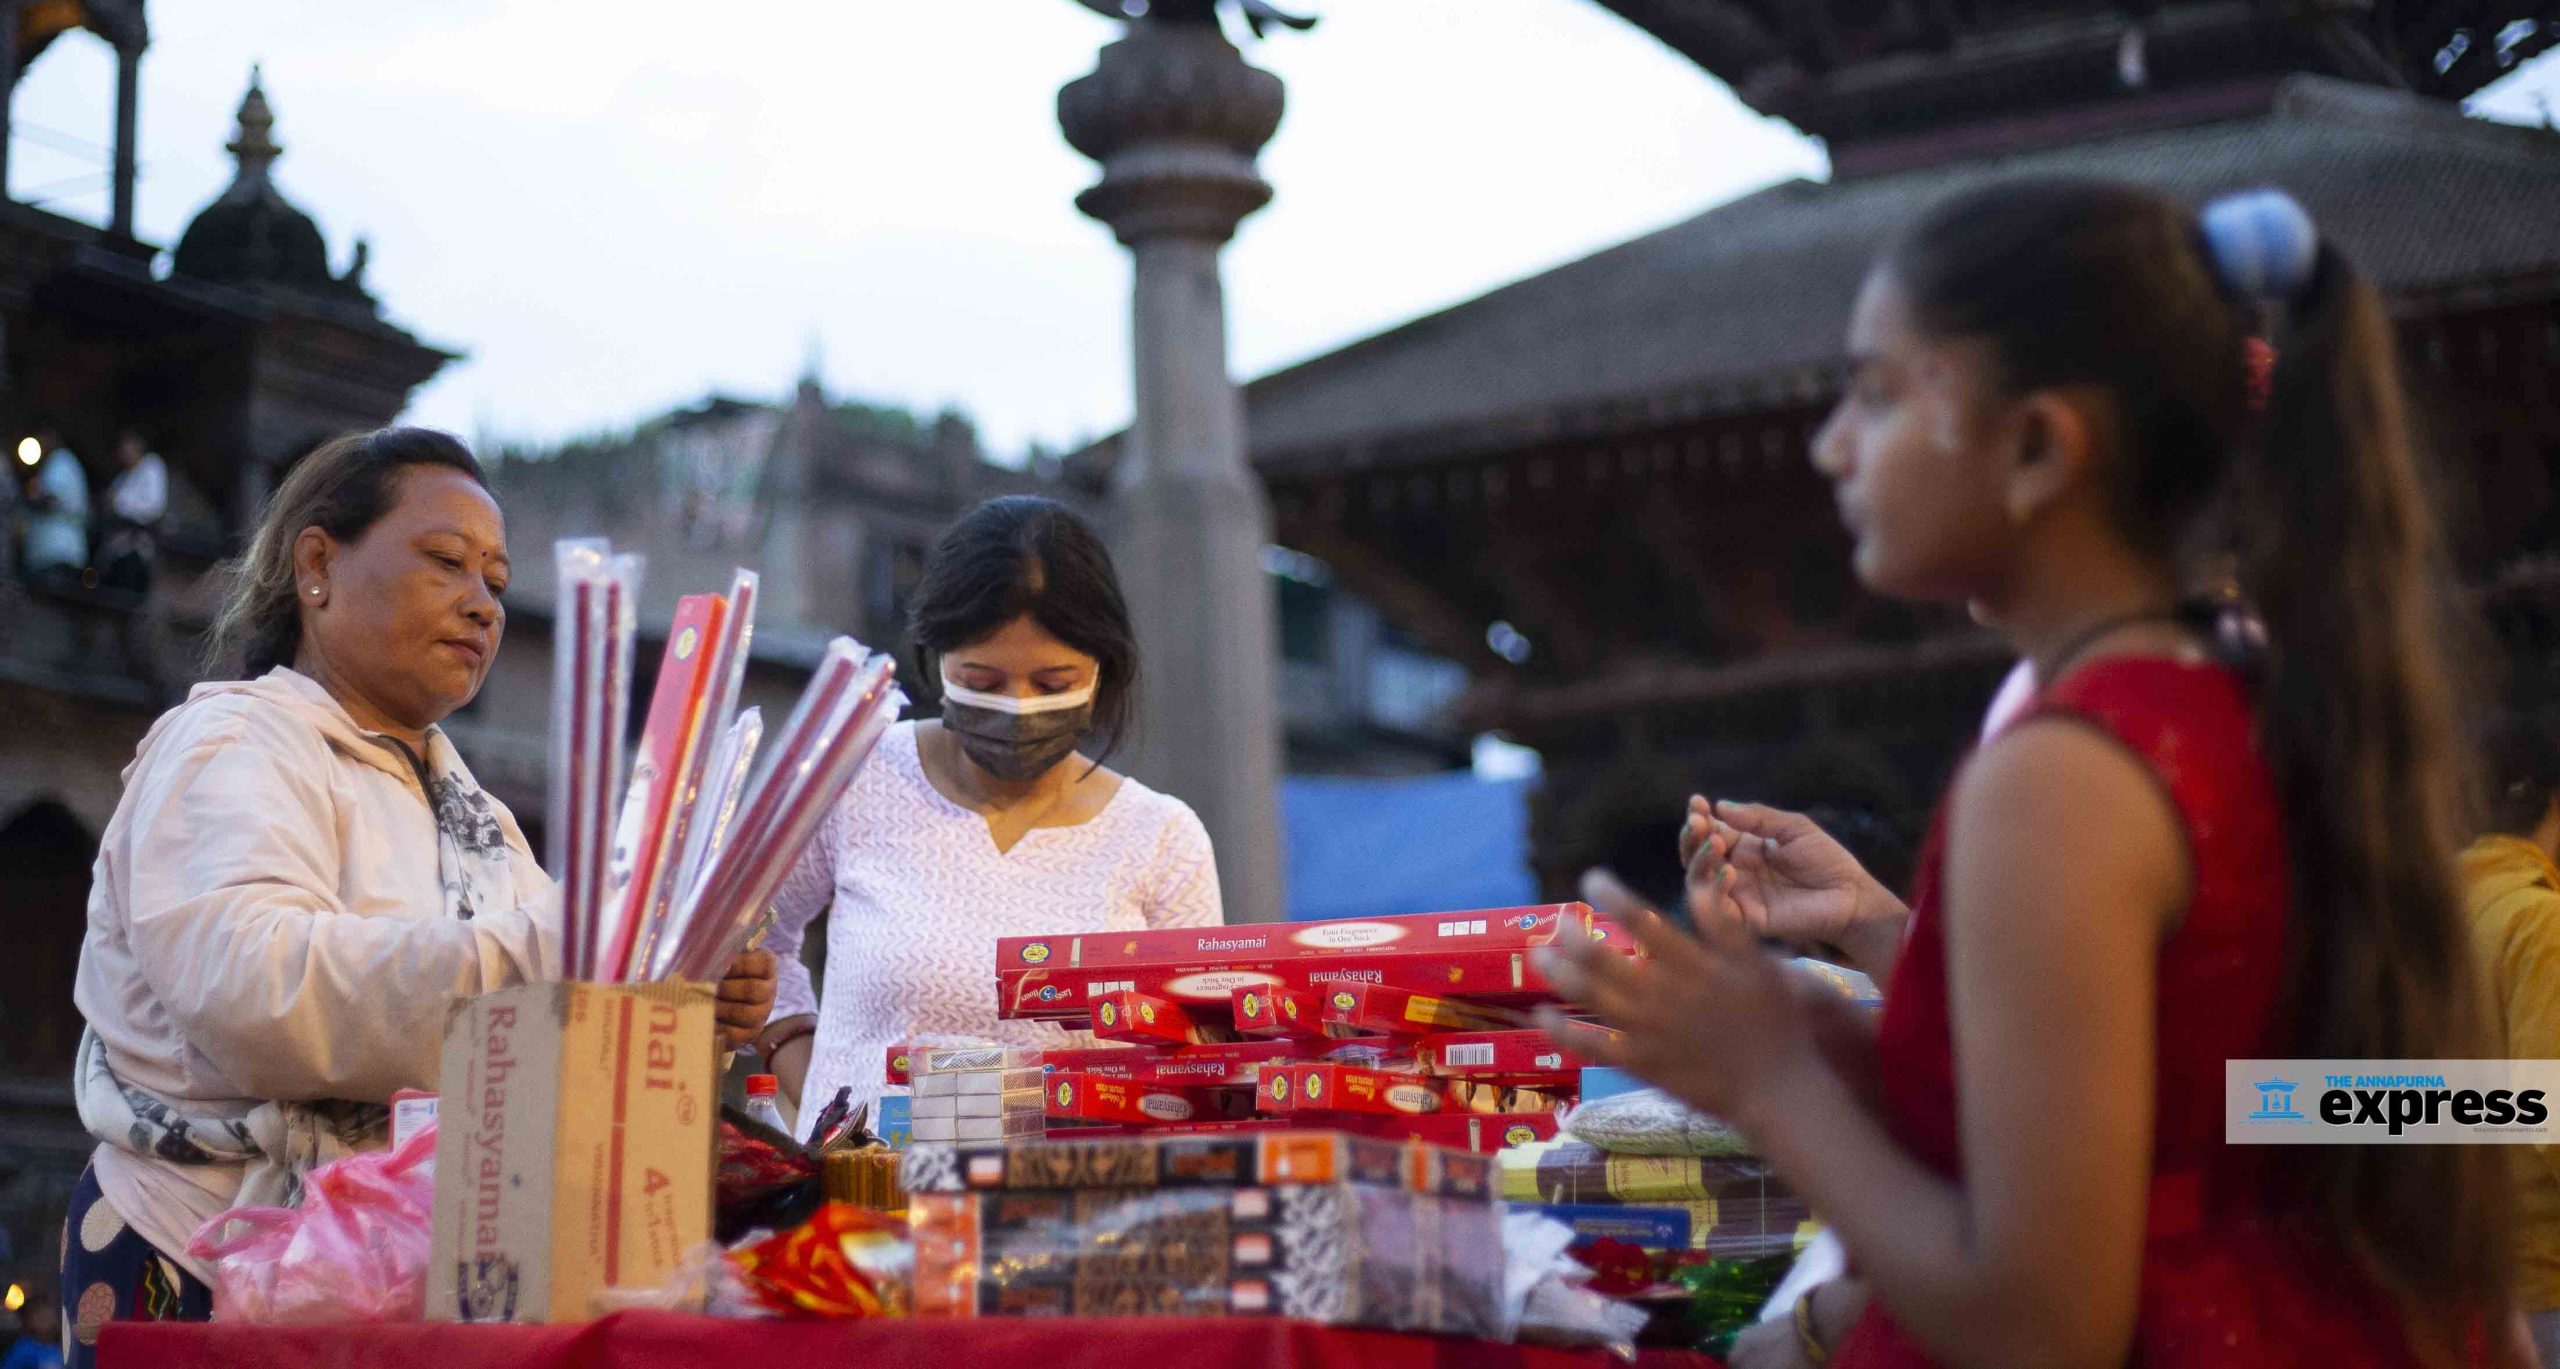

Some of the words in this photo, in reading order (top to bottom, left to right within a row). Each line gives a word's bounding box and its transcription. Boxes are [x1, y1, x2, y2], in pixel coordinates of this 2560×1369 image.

[1197, 934, 1267, 953] Rahasyamai
[1309, 969, 1383, 987] Rahasyamai
[1155, 1062, 1225, 1079] Rahasyamai
[1143, 1096, 1188, 1119] Rahasyamai
